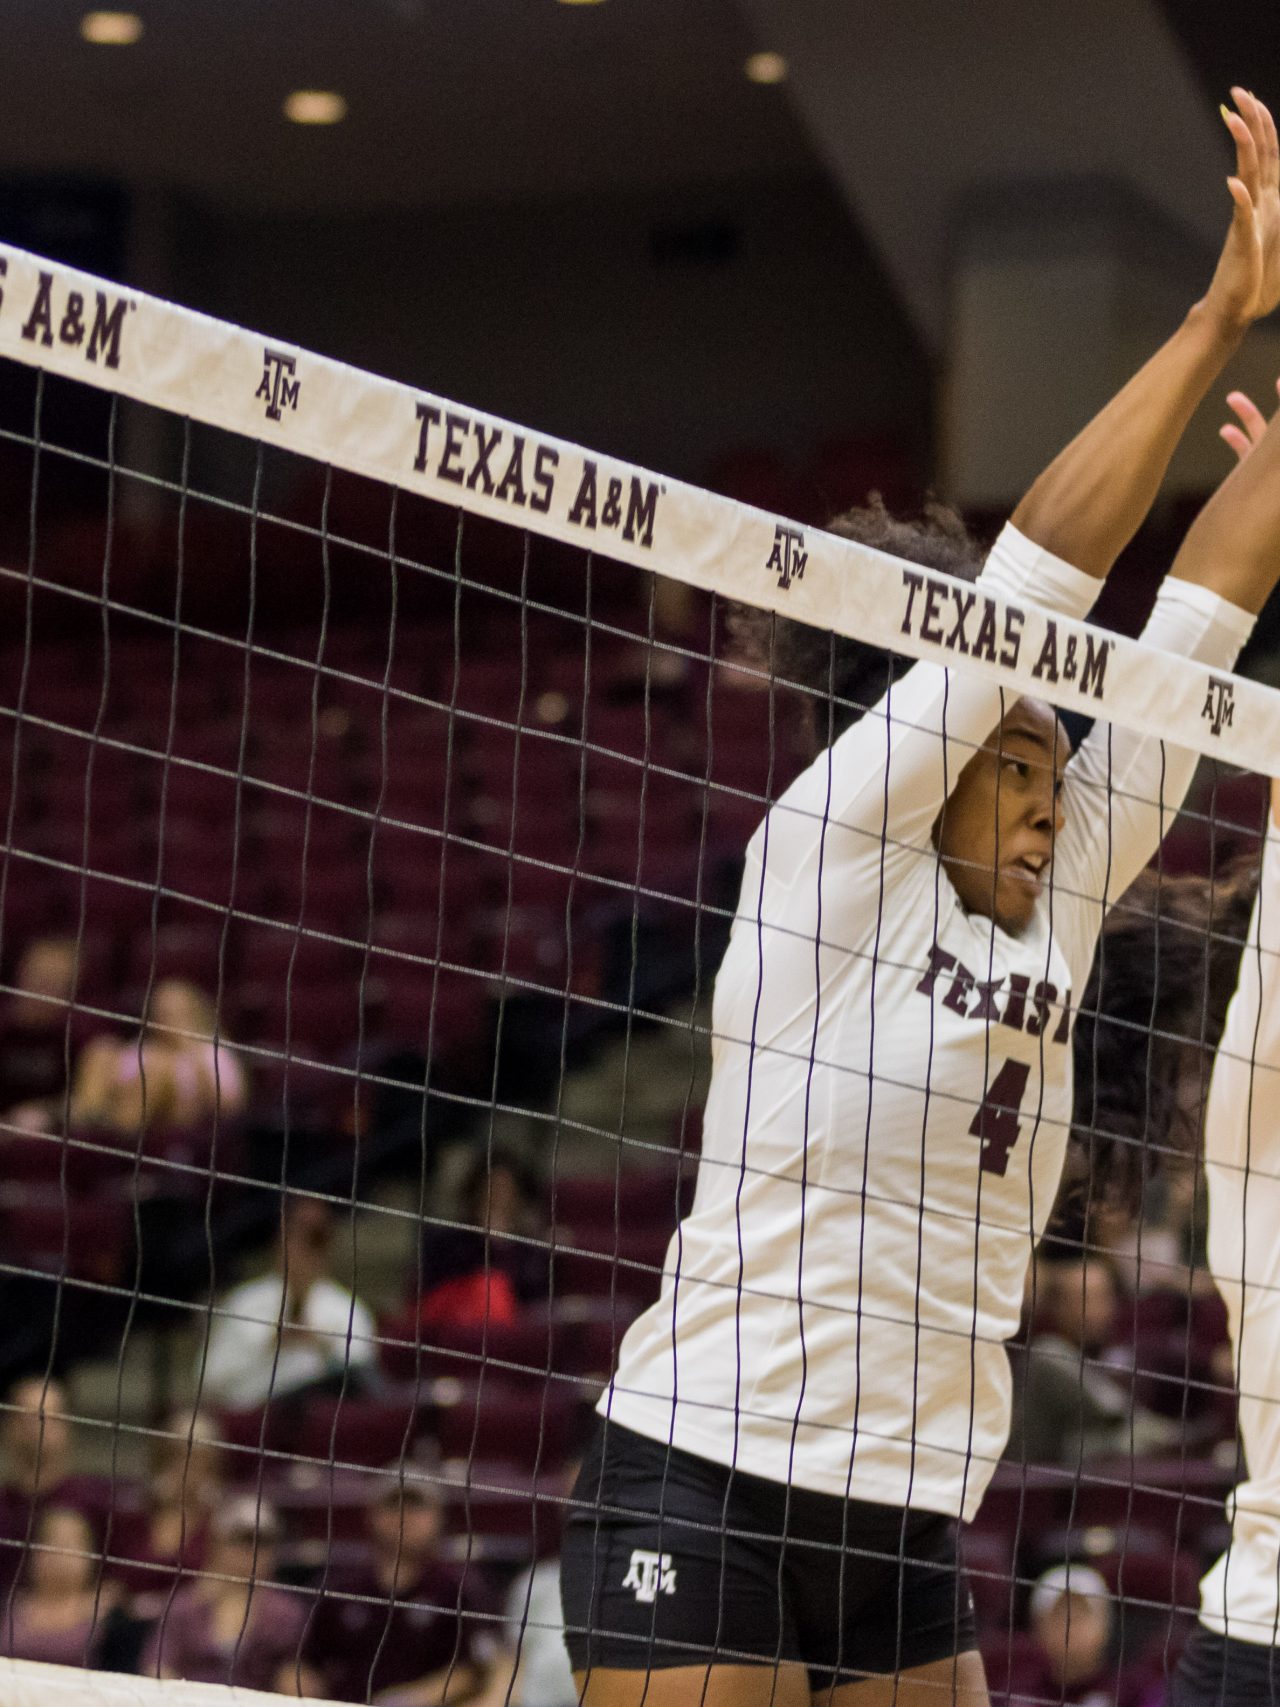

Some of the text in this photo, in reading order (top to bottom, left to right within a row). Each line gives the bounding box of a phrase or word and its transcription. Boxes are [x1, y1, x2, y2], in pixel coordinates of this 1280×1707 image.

[21, 270, 128, 370] A&M
[413, 401, 660, 550] TEXAS A&M
[900, 569, 1110, 701] TEXAS A&M
[967, 1056, 1032, 1179] 4
